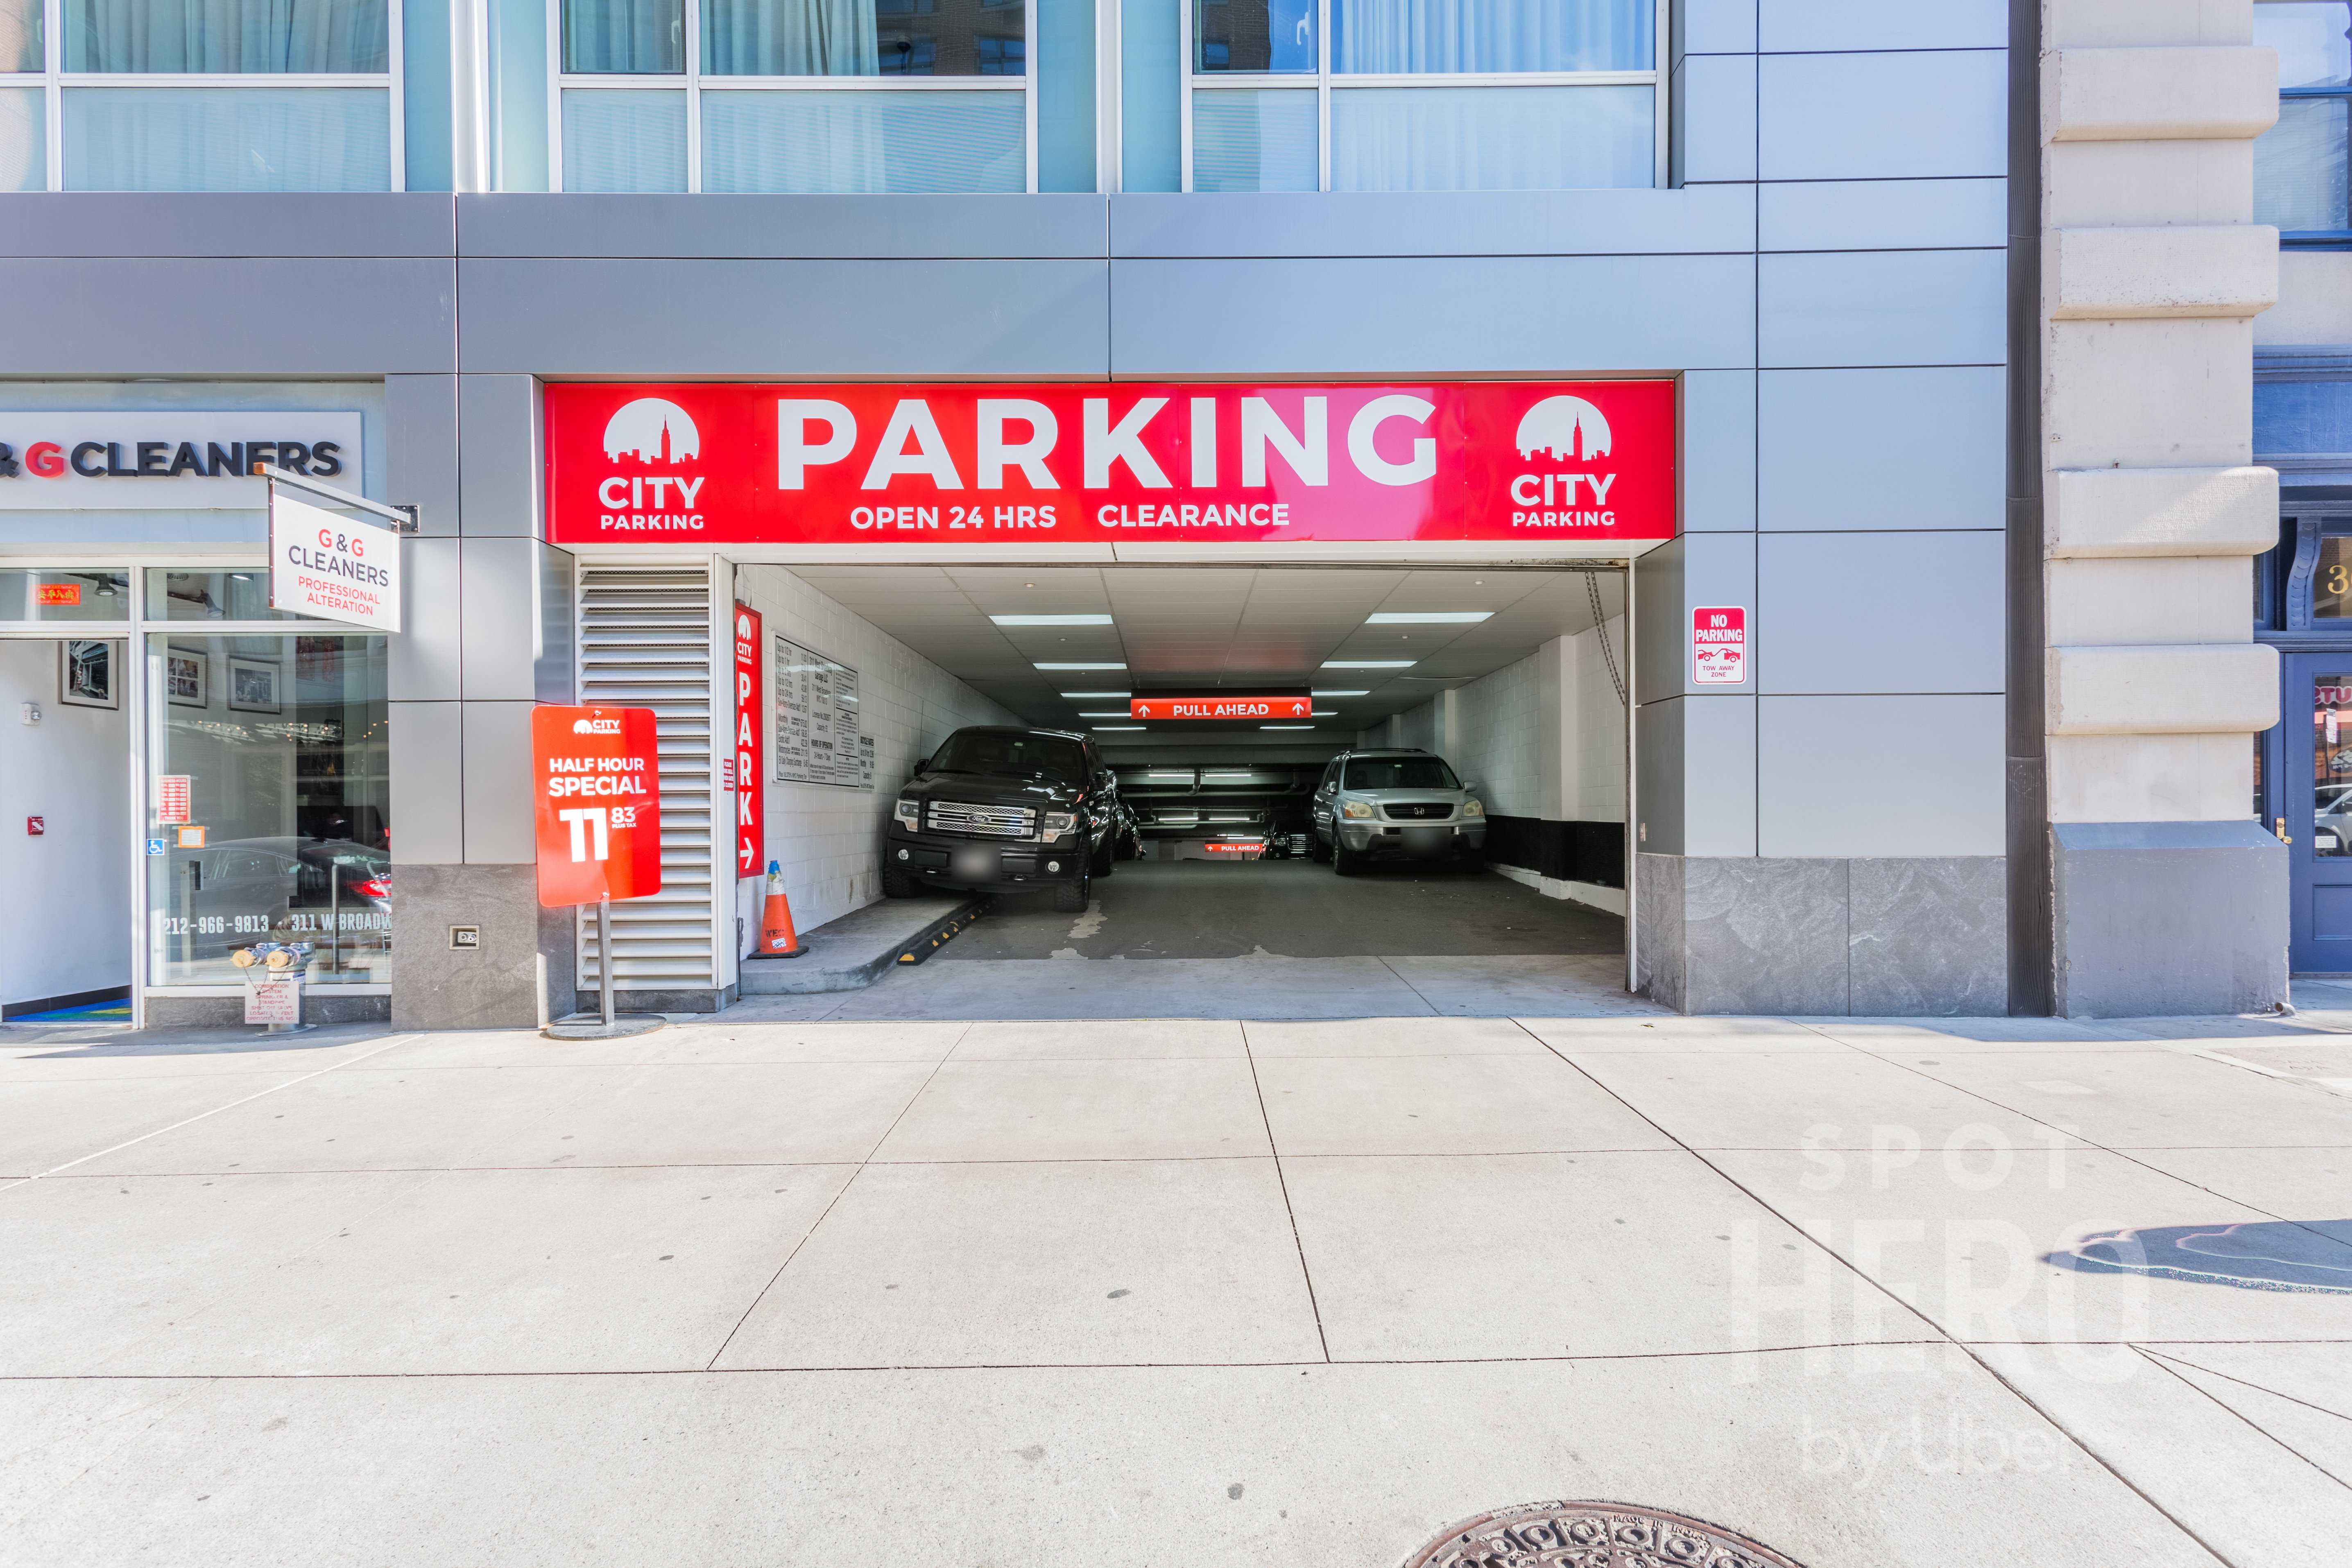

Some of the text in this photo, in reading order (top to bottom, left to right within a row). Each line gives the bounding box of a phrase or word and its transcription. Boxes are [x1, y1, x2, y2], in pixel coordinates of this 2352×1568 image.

[778, 394, 1436, 490] PARKING
[70, 441, 342, 478] CLEANERS
[598, 477, 704, 509] CITY
[1510, 473, 1616, 506] CITY
[600, 515, 704, 530] PARKING
[850, 503, 1290, 529] OPEN 24 HRS CLEARANCE
[1512, 511, 1616, 527] PARKING
[318, 529, 364, 557] G & G
[289, 545, 389, 587] CLEANERS
[298, 576, 380, 604] PROFESSIONAL
[307, 592, 373, 616] ALTERATION
[1711, 615, 1727, 628] NO
[1696, 629, 1743, 642] PARKING
[737, 641, 752, 657] CITY
[737, 655, 752, 665] PARKING
[1173, 704, 1269, 716] PULL AHEAD
[592, 720, 620, 729] CITY
[738, 672, 753, 825] PARK
[550, 757, 645, 773] HALF HOUR
[549, 776, 647, 797] SPECIAL
[611, 807, 636, 824] 83
[559, 808, 609, 862] 11
[164, 915, 269, 935] 212-966-9813
[291, 914, 317, 932] 311
[321, 914, 334, 931] W
